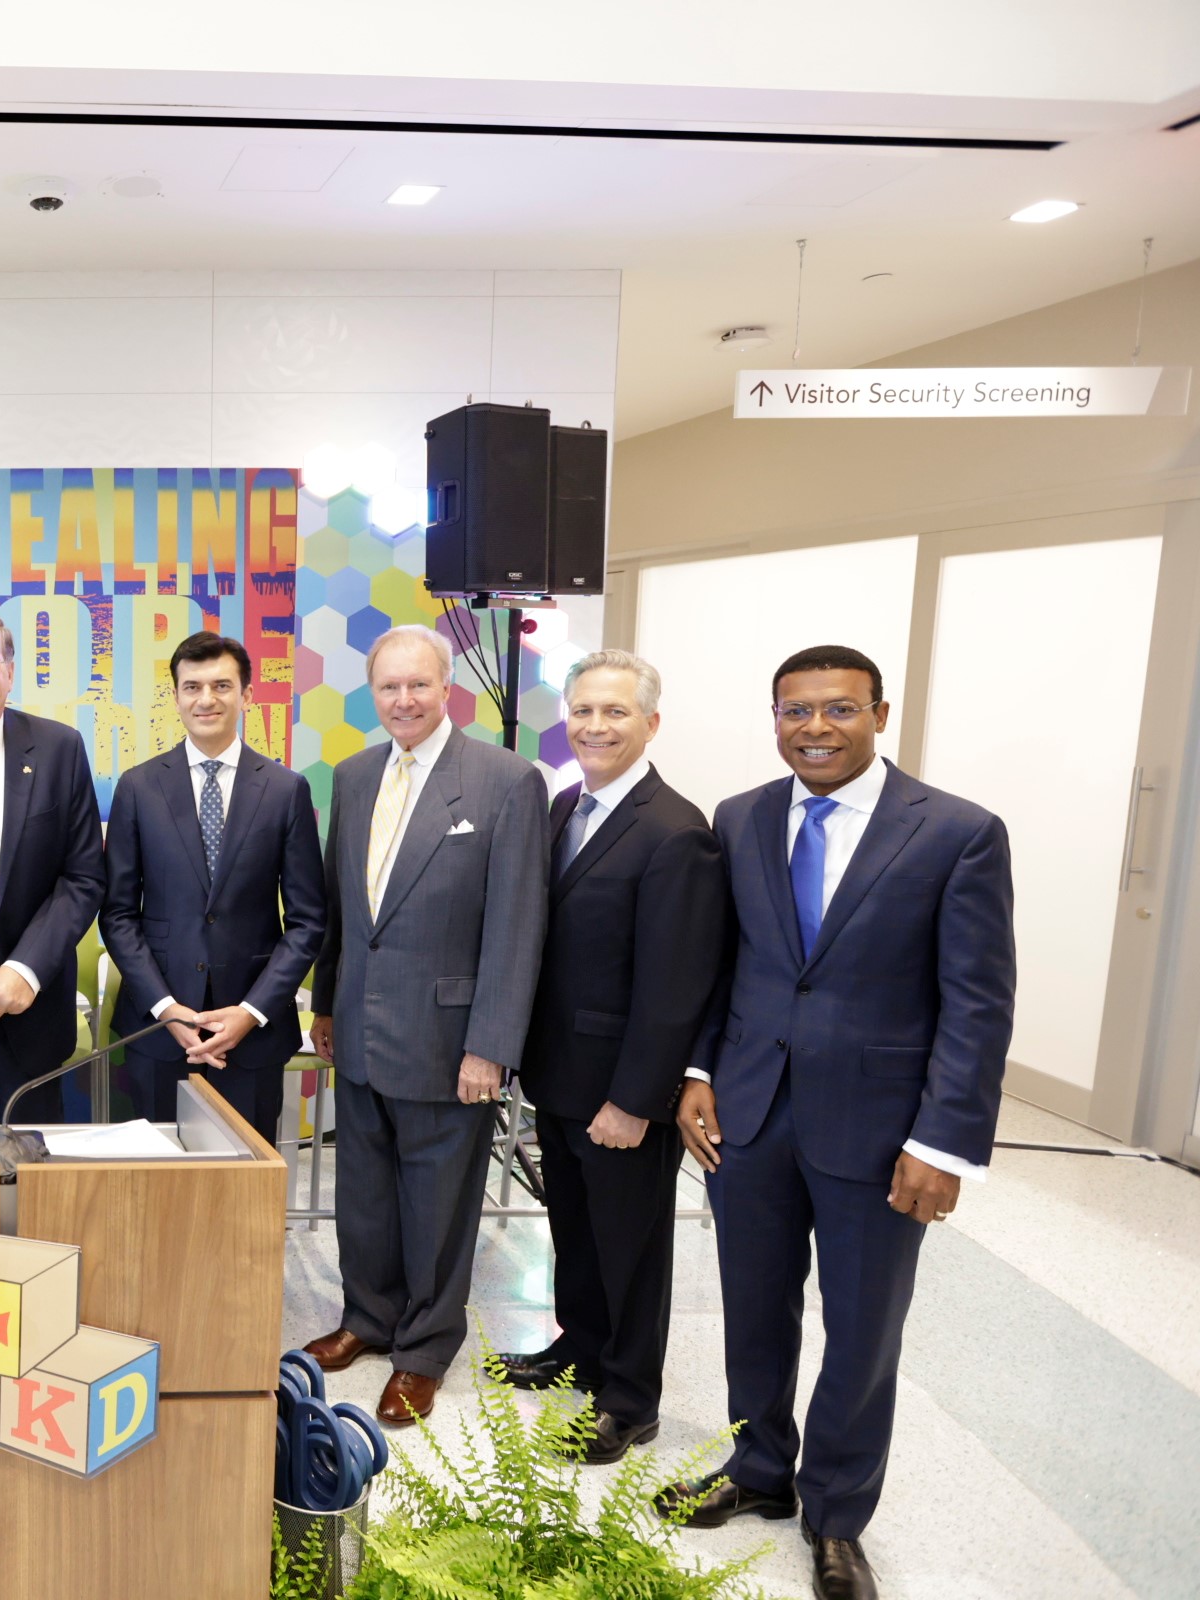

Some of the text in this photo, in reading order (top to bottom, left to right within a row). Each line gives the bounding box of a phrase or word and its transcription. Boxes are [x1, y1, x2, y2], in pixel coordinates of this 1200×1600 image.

[784, 381, 1091, 409] Visitor Security Screening
